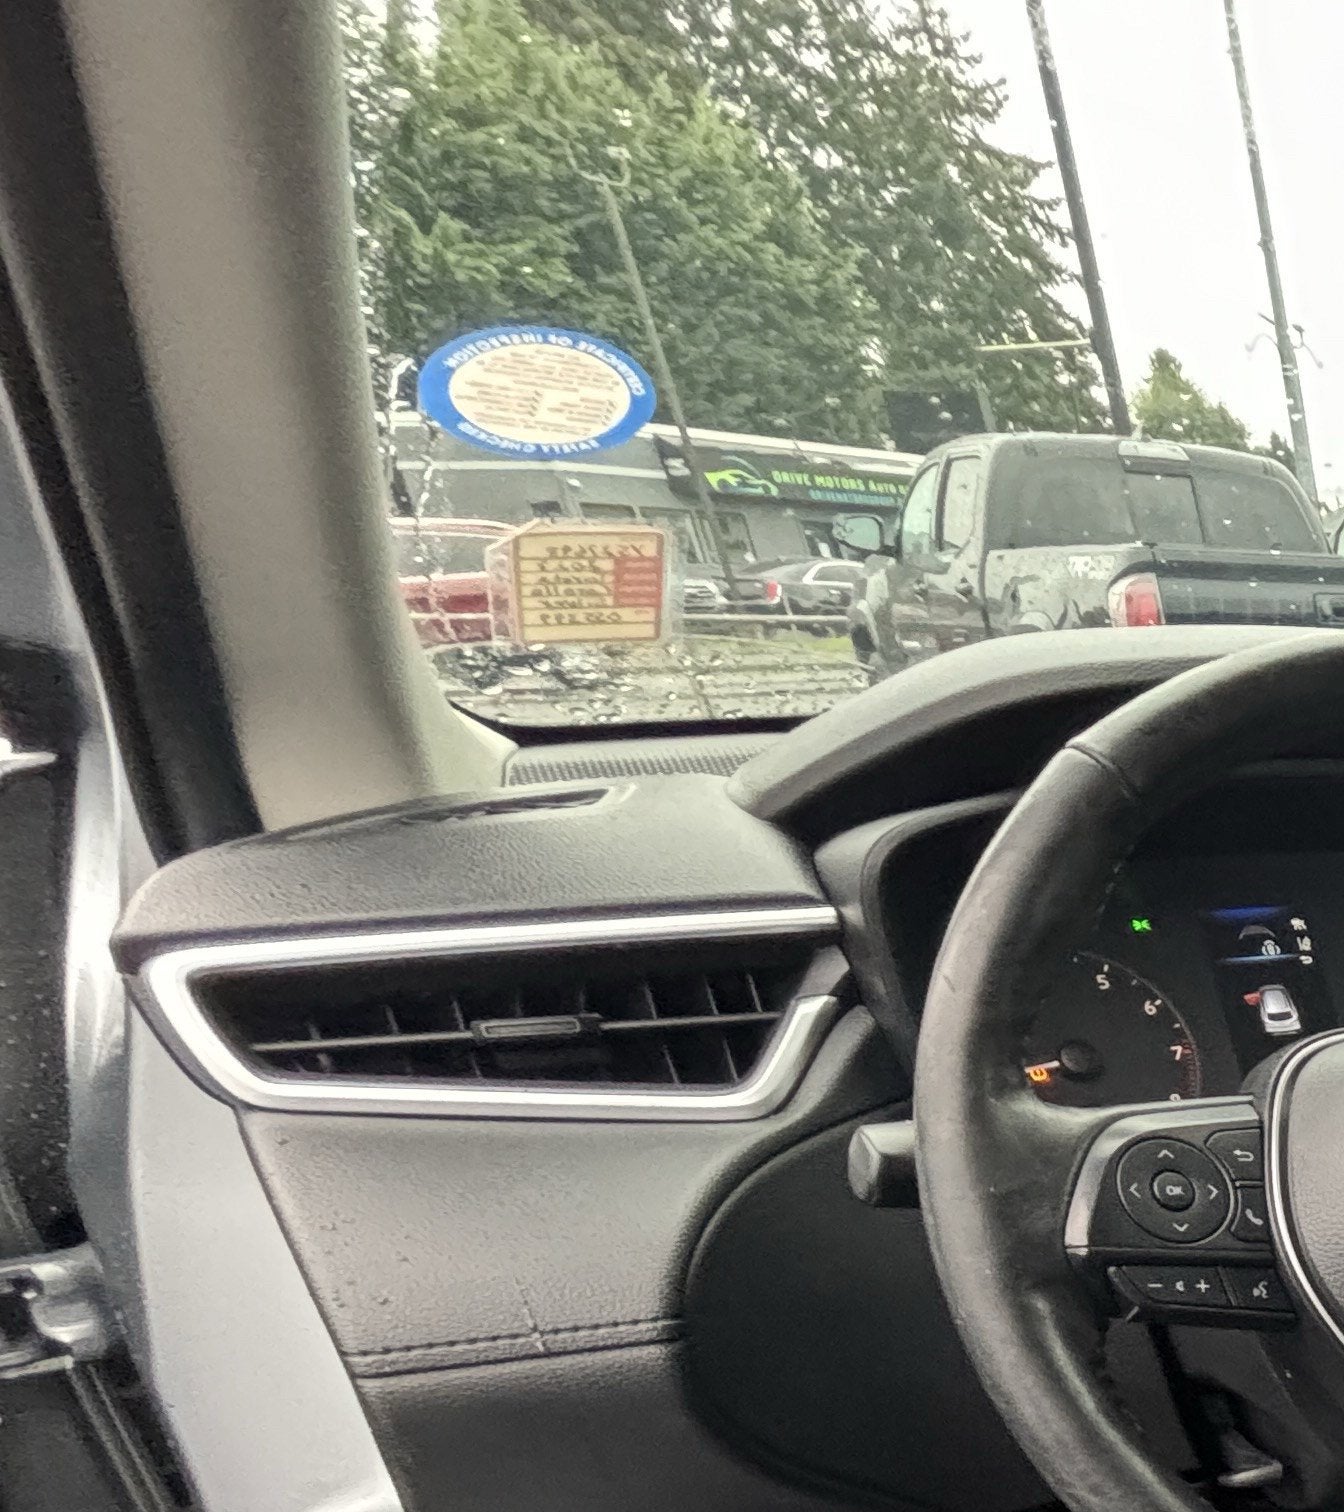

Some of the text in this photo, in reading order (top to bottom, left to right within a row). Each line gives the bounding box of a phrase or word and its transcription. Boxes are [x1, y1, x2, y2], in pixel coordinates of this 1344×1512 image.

[1095, 974, 1110, 990] 5
[1144, 1000, 1157, 1015] 6
[1169, 1045, 1182, 1061] 7
[1165, 1185, 1185, 1196] OK
